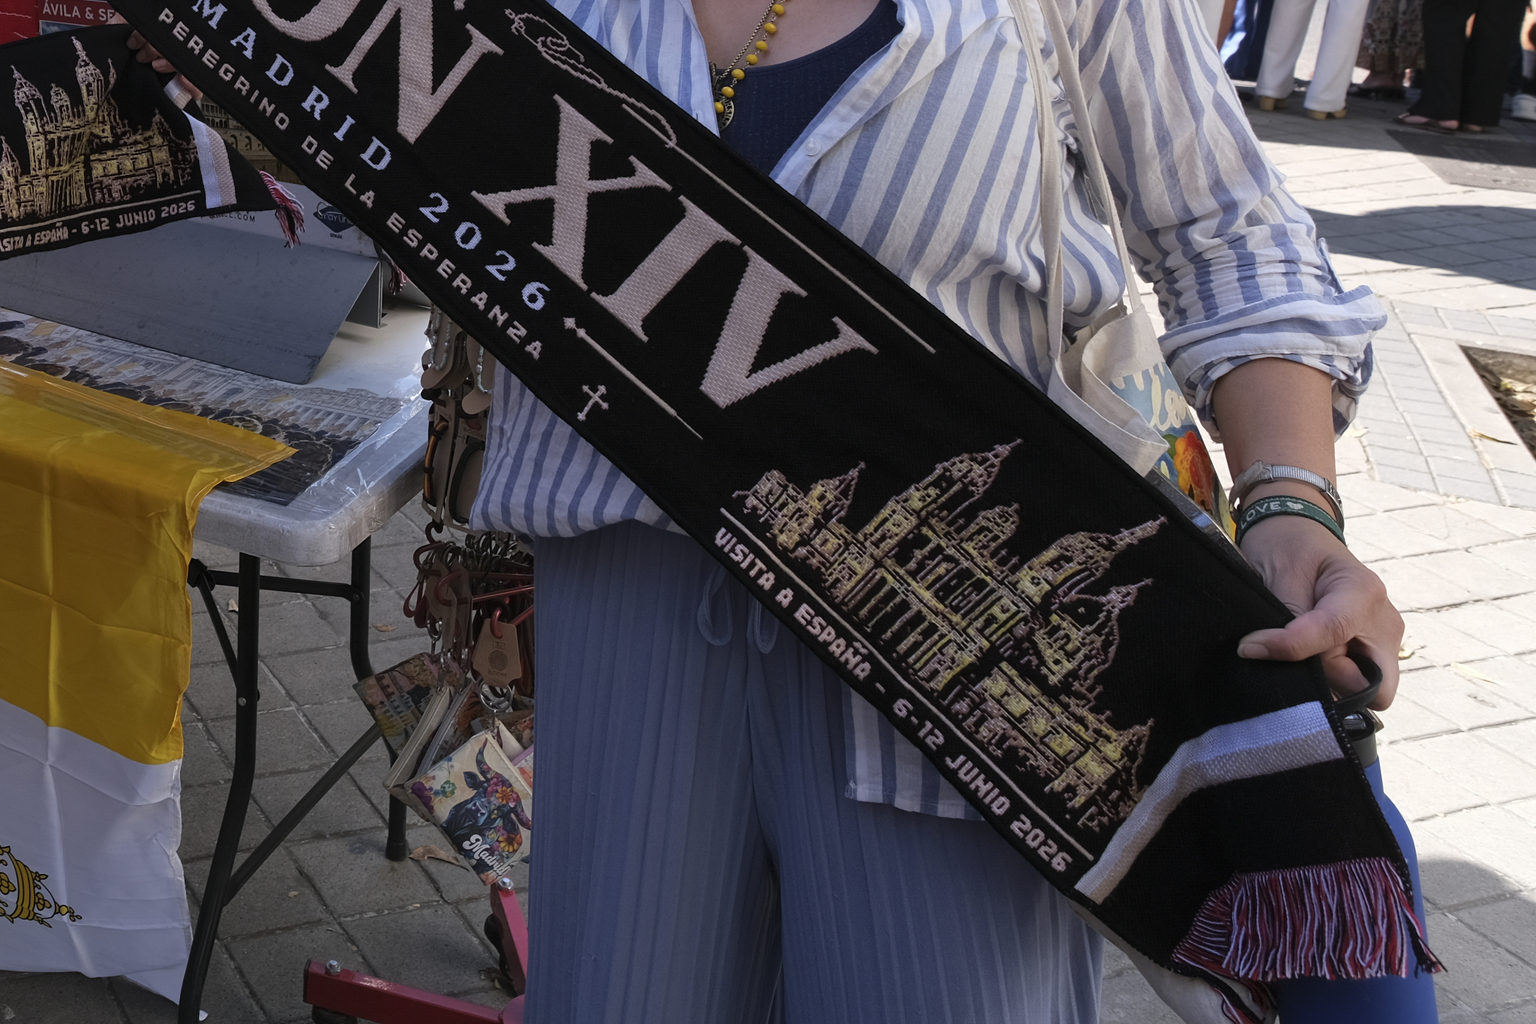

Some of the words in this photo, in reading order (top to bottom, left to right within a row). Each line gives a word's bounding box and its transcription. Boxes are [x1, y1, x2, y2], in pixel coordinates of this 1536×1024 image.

[42, 0, 81, 19] ÁVILA
[84, 7, 95, 20] &
[98, 8, 116, 22] SE
[25, 234, 32, 247] A
[33, 222, 69, 245] ESPAÑA
[81, 217, 110, 234] 6-12
[116, 208, 156, 228] JUNIO
[161, 199, 196, 218] 2026
[158, 7, 290, 131] PEREGRINO
[300, 135, 335, 170] DE
[344, 173, 375, 210] LA
[385, 212, 544, 361] ESPERANZA
[419, 192, 551, 311] 2026
[470, 93, 880, 410] XIV
[1240, 501, 1282, 530] LOVE
[714, 526, 776, 592] VISITA
[774, 587, 794, 610] A
[793, 602, 873, 681] ESPAÑA
[892, 697, 946, 752] 6-12
[945, 754, 1011, 817] JUNIO
[1009, 814, 1073, 873] 2026
[462, 833, 512, 878] Madrid
